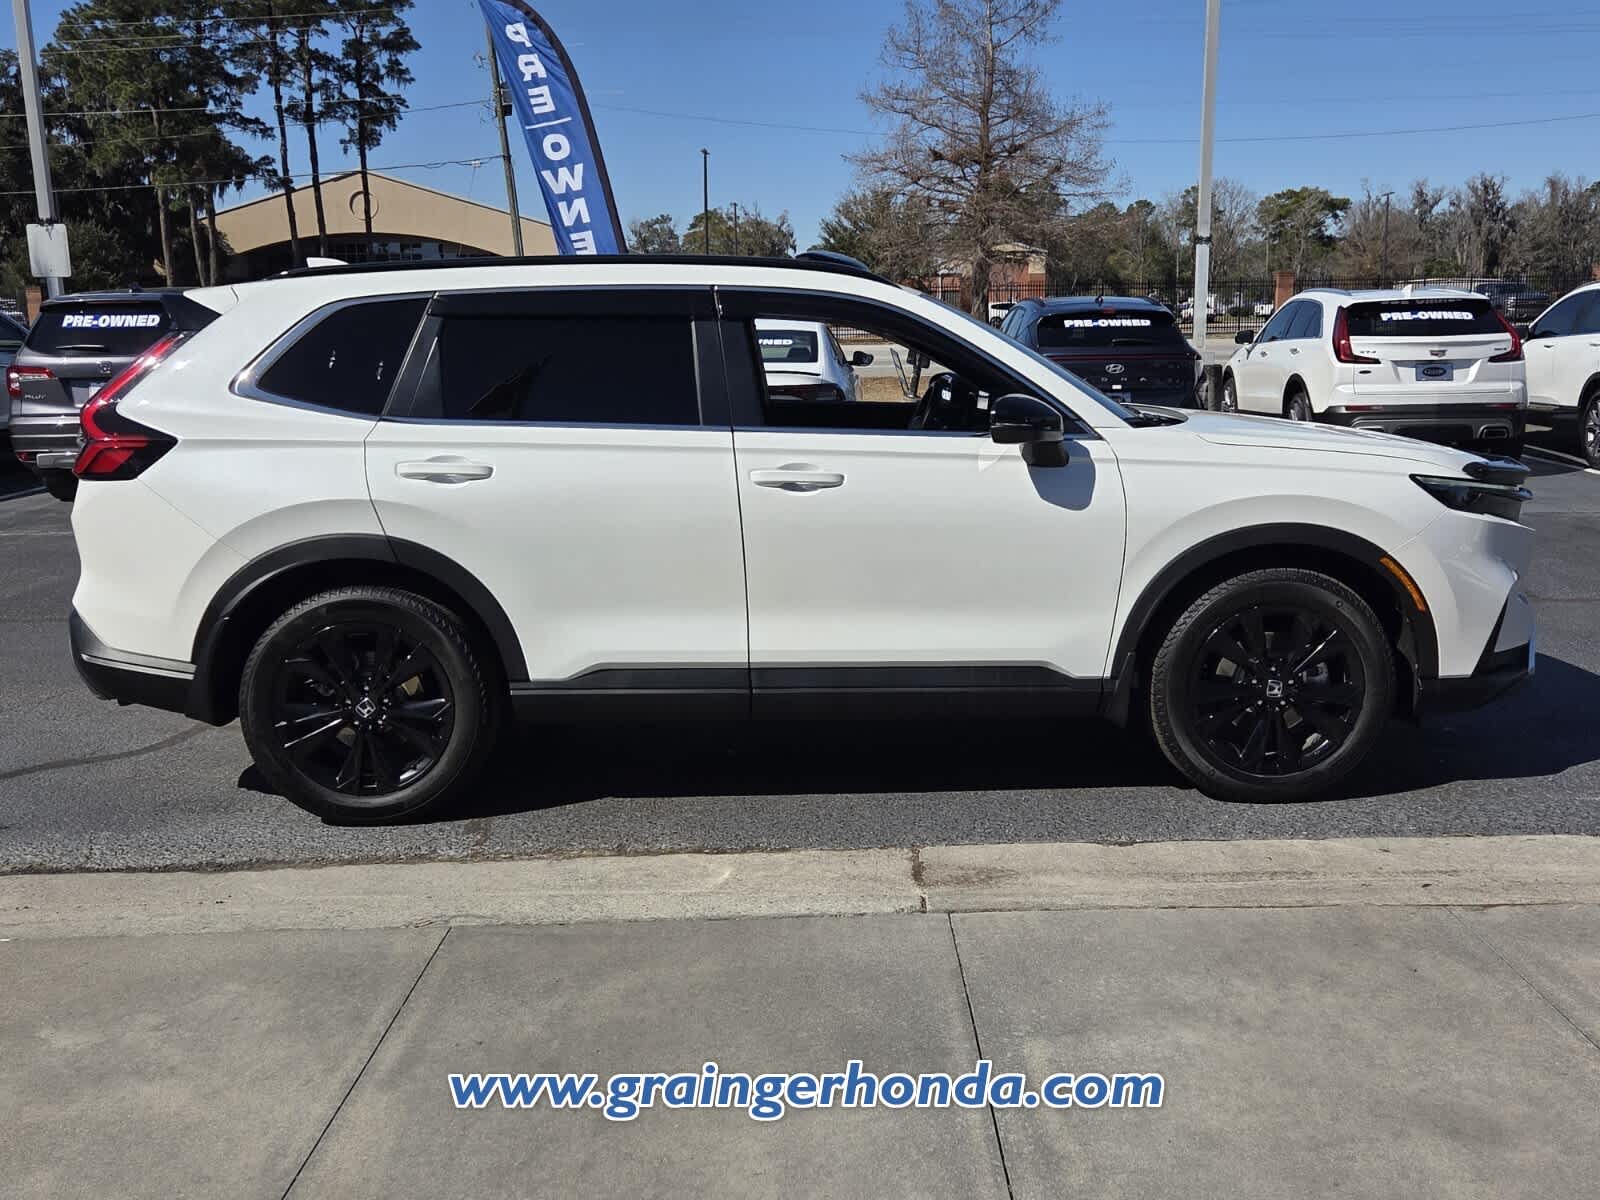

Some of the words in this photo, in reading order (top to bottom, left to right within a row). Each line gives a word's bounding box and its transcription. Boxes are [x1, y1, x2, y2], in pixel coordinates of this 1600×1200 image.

[62, 314, 160, 328] PRE-OWNED
[1380, 311, 1473, 321] PRE-OWNED
[1063, 319, 1151, 328] PRE-OWNED
